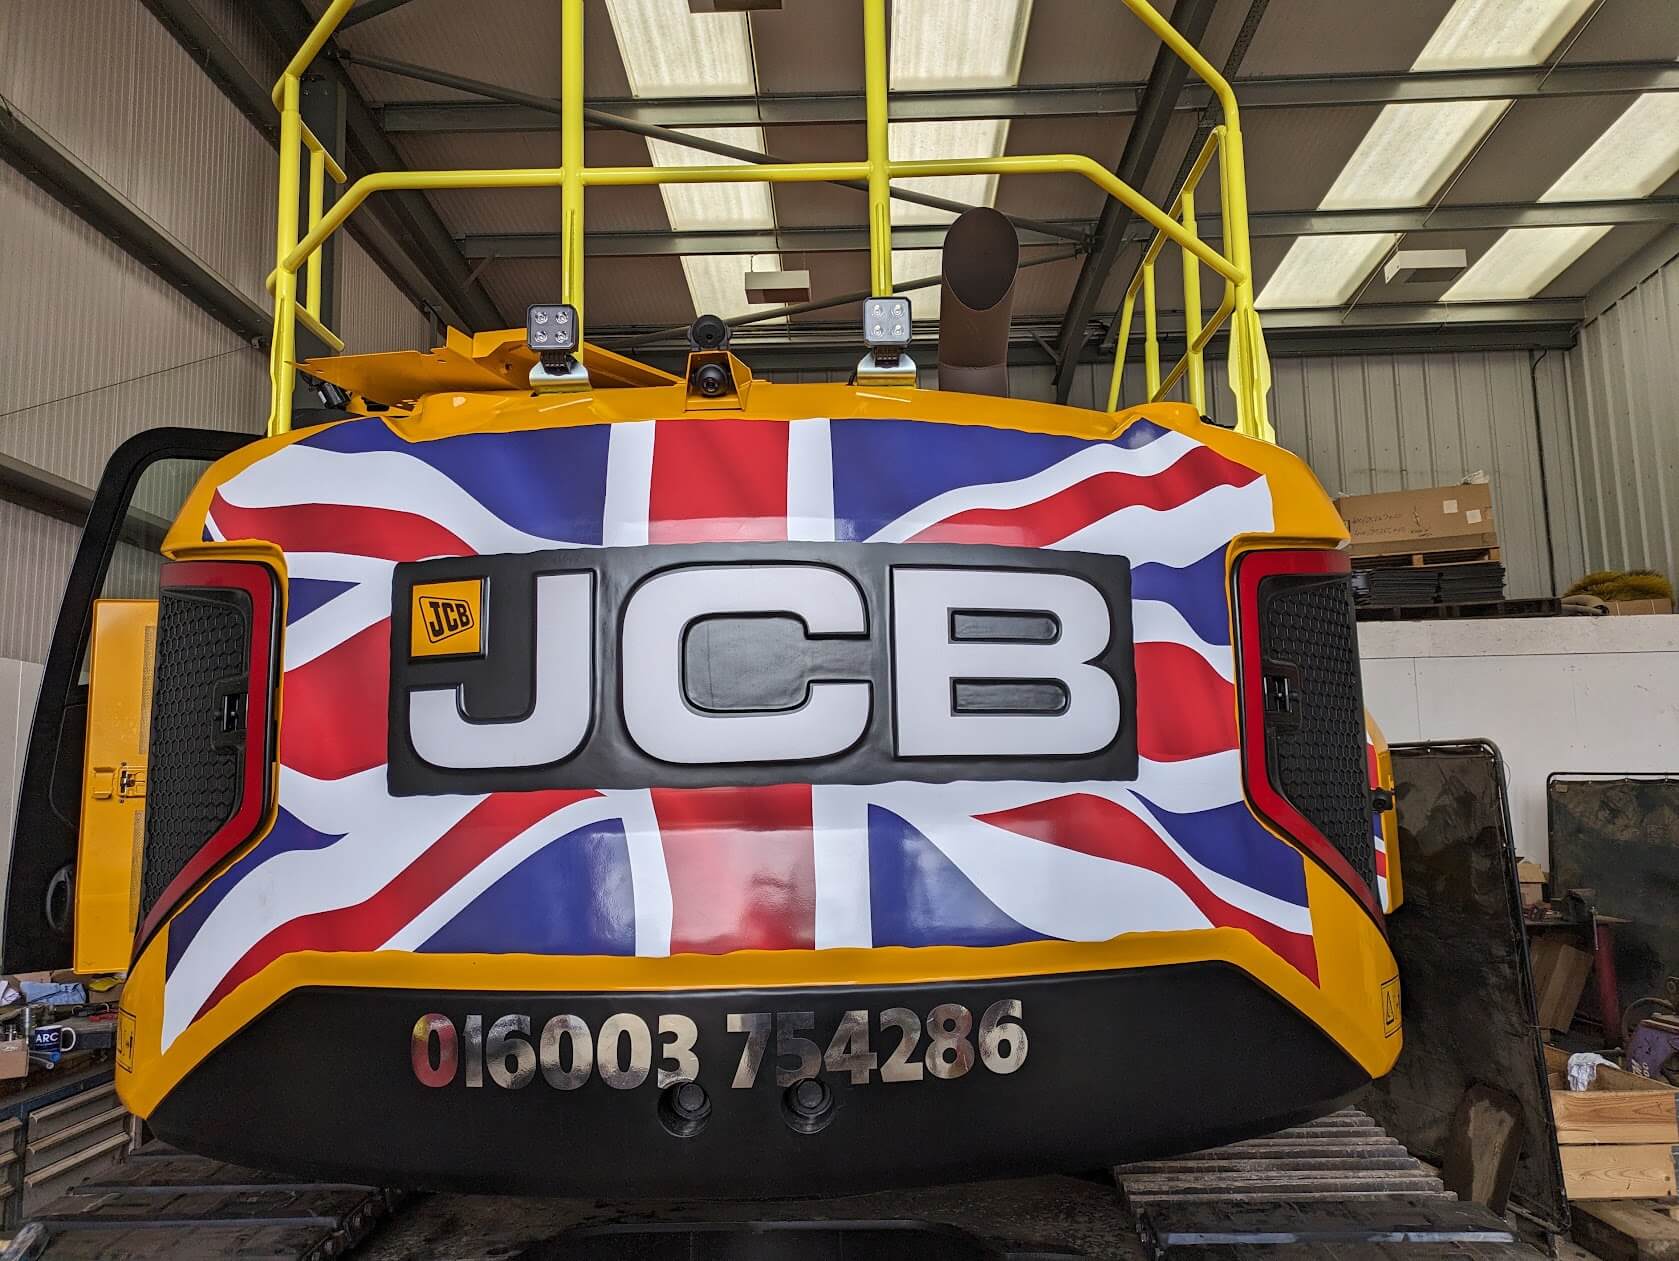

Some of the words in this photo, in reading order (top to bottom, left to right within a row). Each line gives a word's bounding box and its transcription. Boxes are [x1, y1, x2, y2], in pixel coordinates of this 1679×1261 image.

[428, 600, 471, 638] JCB
[409, 565, 1121, 769] JCB
[35, 1032, 60, 1043] ARC
[411, 1013, 700, 1090] 016003
[726, 1000, 1029, 1089] 754286
